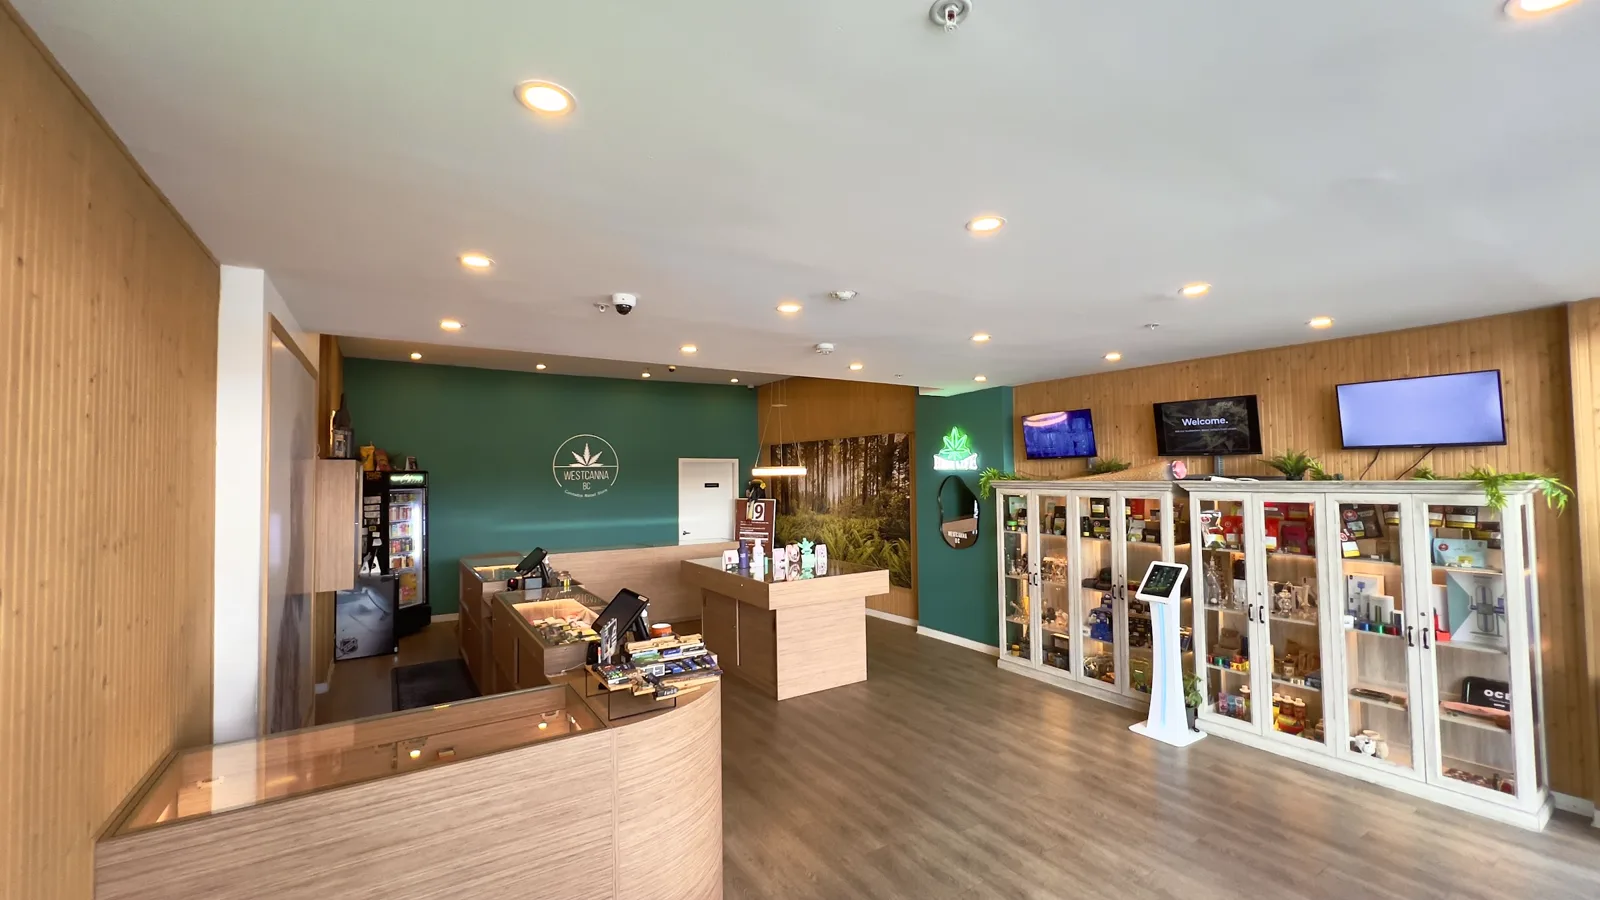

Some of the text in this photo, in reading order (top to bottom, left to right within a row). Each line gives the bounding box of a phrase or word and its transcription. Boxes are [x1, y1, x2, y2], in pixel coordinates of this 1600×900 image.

[1182, 418, 1228, 426] Welcome.
[564, 470, 610, 480] WESTCANNA
[582, 482, 591, 490] BC
